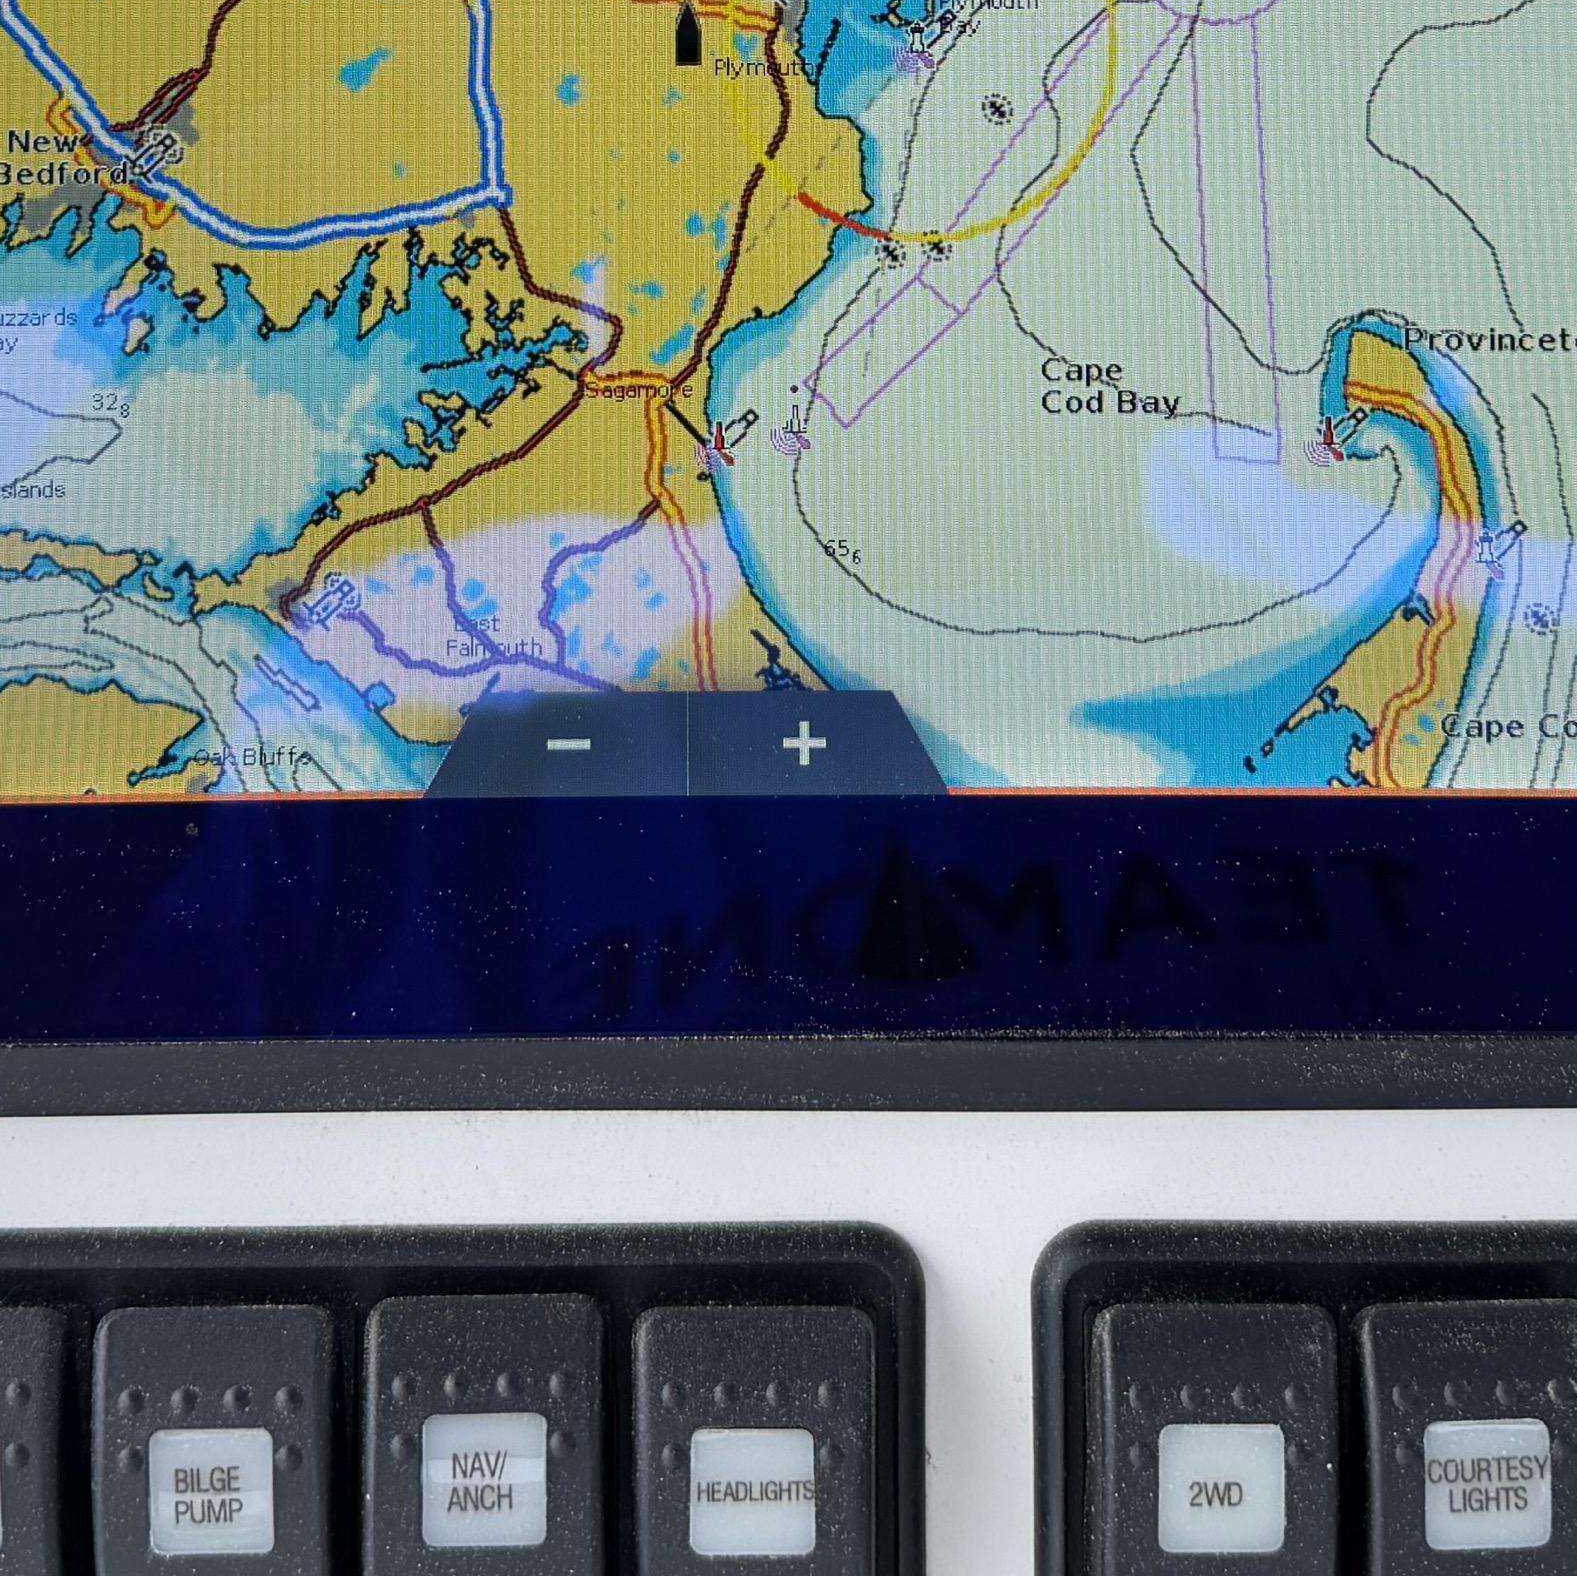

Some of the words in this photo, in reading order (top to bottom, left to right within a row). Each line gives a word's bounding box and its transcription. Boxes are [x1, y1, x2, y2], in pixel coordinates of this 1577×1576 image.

[8, 129, 79, 153] New
[1041, 357, 1123, 384] Cape
[585, 381, 694, 403] Sagamore
[1041, 389, 1103, 415] Cod
[1116, 390, 1181, 419] Bay
[1440, 713, 1525, 743] Cape
[451, 1450, 509, 1481] NAV/
[1427, 1455, 1549, 1485] COURTESY
[174, 1466, 241, 1495] BILGE
[696, 1479, 816, 1503] HEADLIGHTS
[446, 1484, 514, 1514] ANCH
[1189, 1481, 1244, 1508] 2WD
[1448, 1486, 1529, 1513] LIGHTS
[174, 1498, 244, 1525] PUMP
